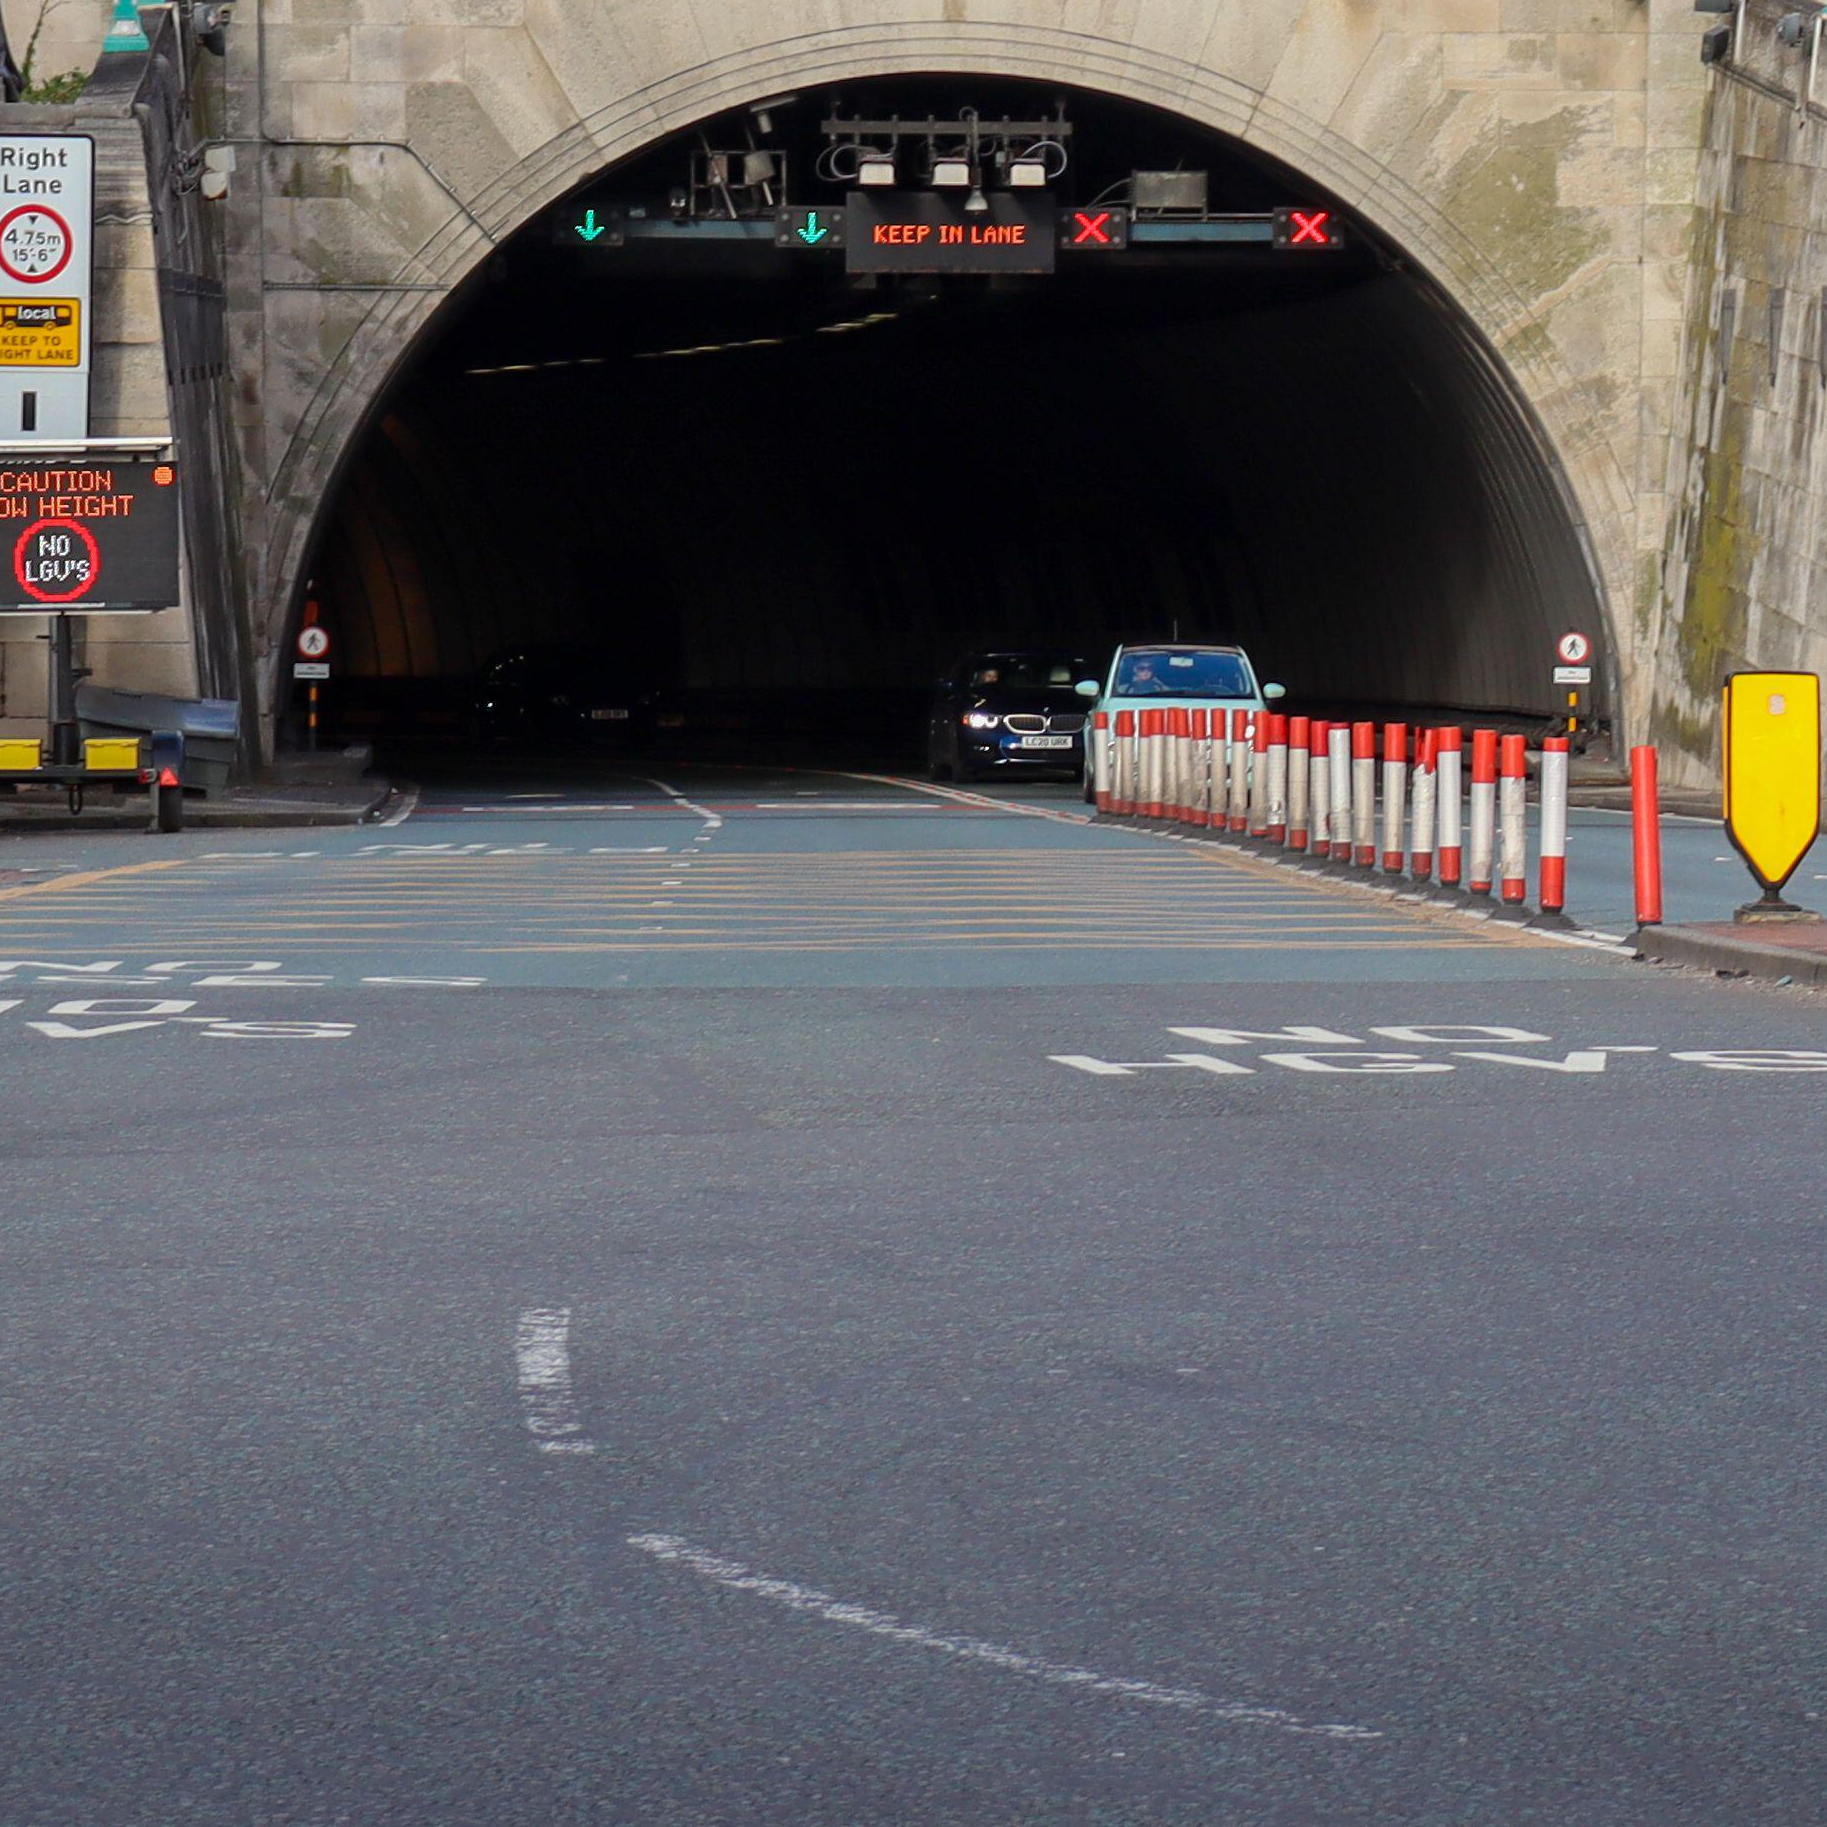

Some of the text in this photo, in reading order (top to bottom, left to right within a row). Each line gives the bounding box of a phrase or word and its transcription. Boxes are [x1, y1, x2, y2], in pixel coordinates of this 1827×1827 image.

[0, 147, 68, 170] Right
[3, 174, 63, 194] Lane
[4, 228, 62, 245] 4.75m
[873, 225, 1025, 244] KEEP IN LANE
[17, 305, 57, 320] local
[1, 335, 61, 346] KEEP TO
[37, 349, 74, 360] LANE
[0, 470, 111, 492] CAUTION
[39, 495, 134, 517] HEIGHT
[39, 535, 70, 557] NO
[26, 559, 90, 582] LGV'S
[1165, 1025, 1554, 1045] NO
